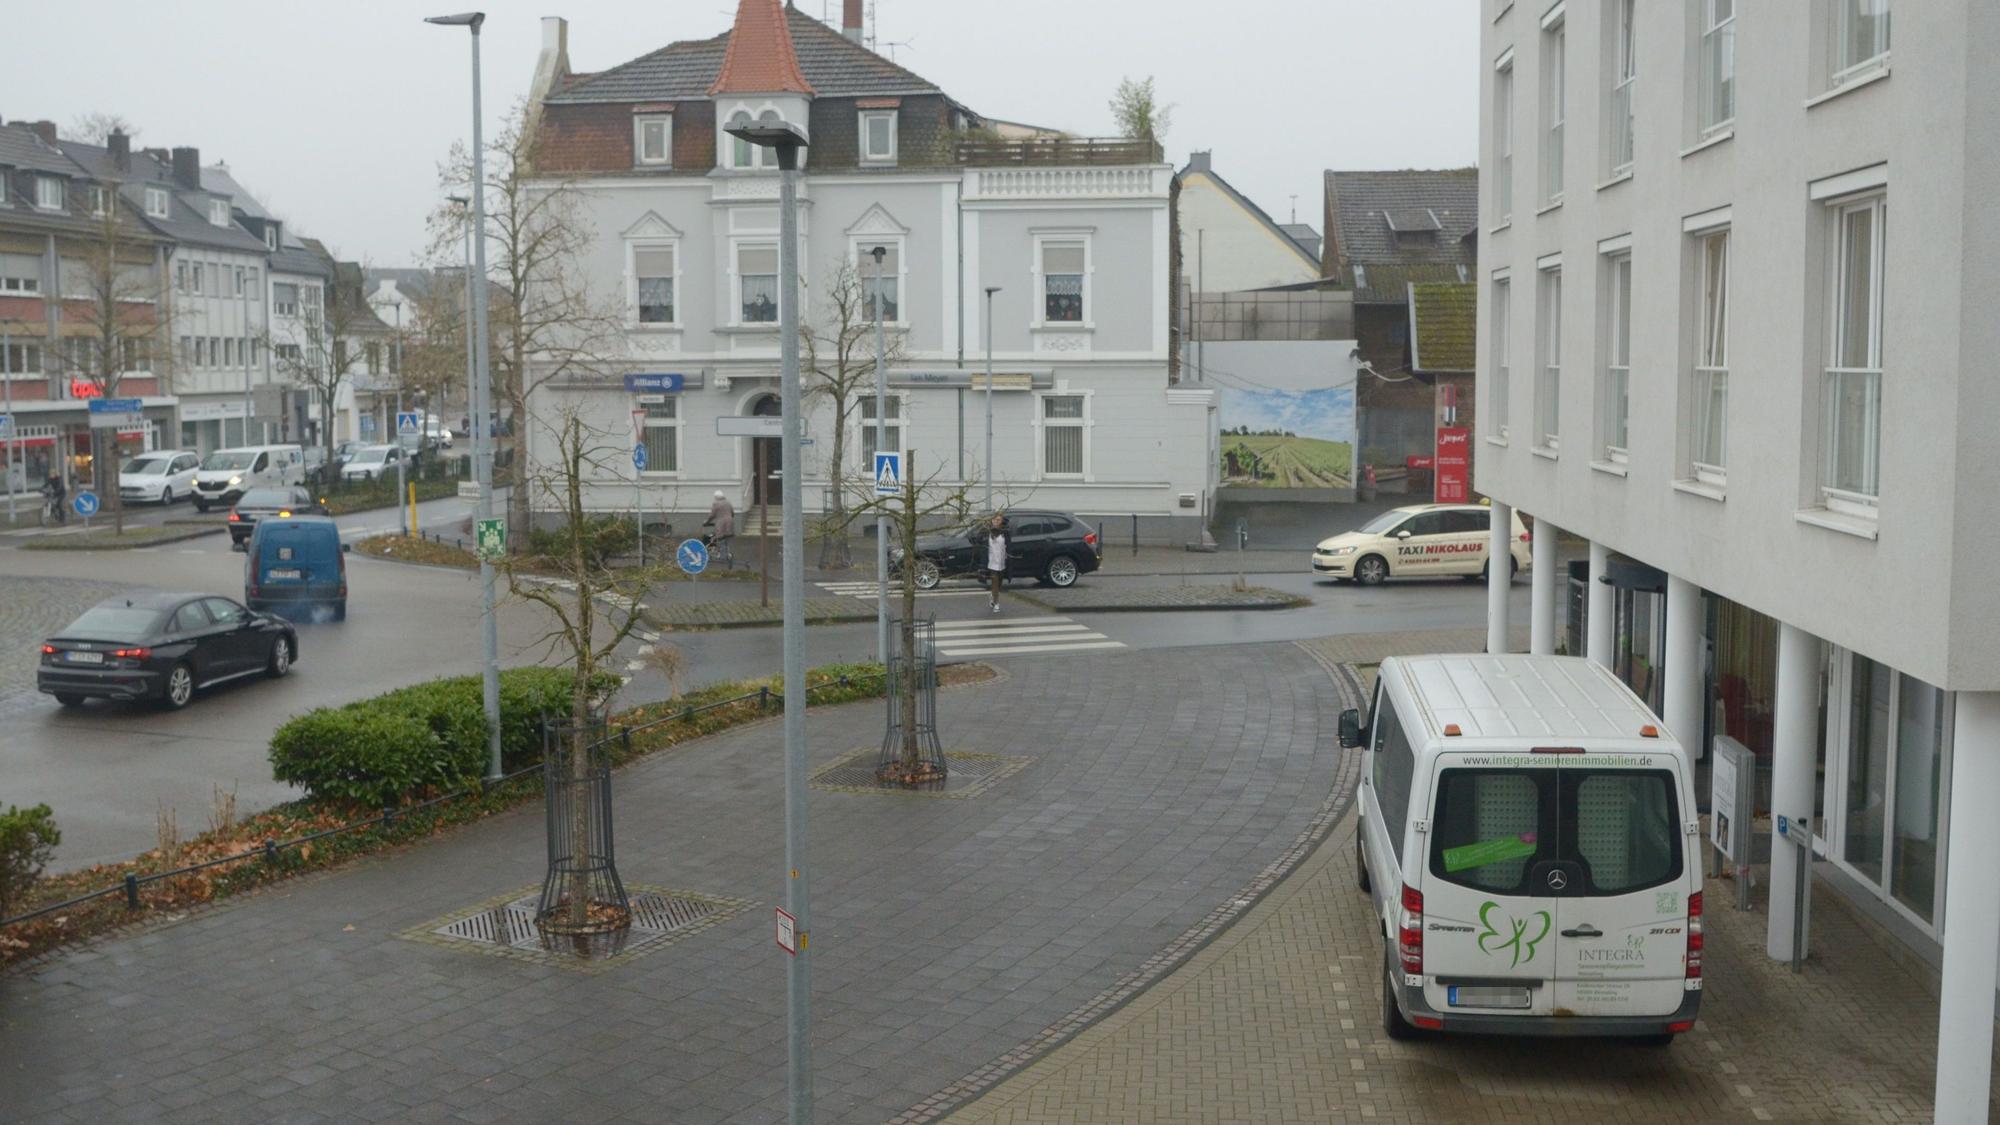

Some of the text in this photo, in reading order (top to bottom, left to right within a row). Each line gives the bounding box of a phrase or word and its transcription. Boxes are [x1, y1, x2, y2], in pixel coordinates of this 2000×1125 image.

[633, 378, 661, 387] Allianz
[1397, 543, 1483, 556] TAXI NIKOLAUS
[1462, 755, 1653, 767] www.integra-seniorenimmobilien.de
[1578, 949, 1645, 961] INTEGRA
